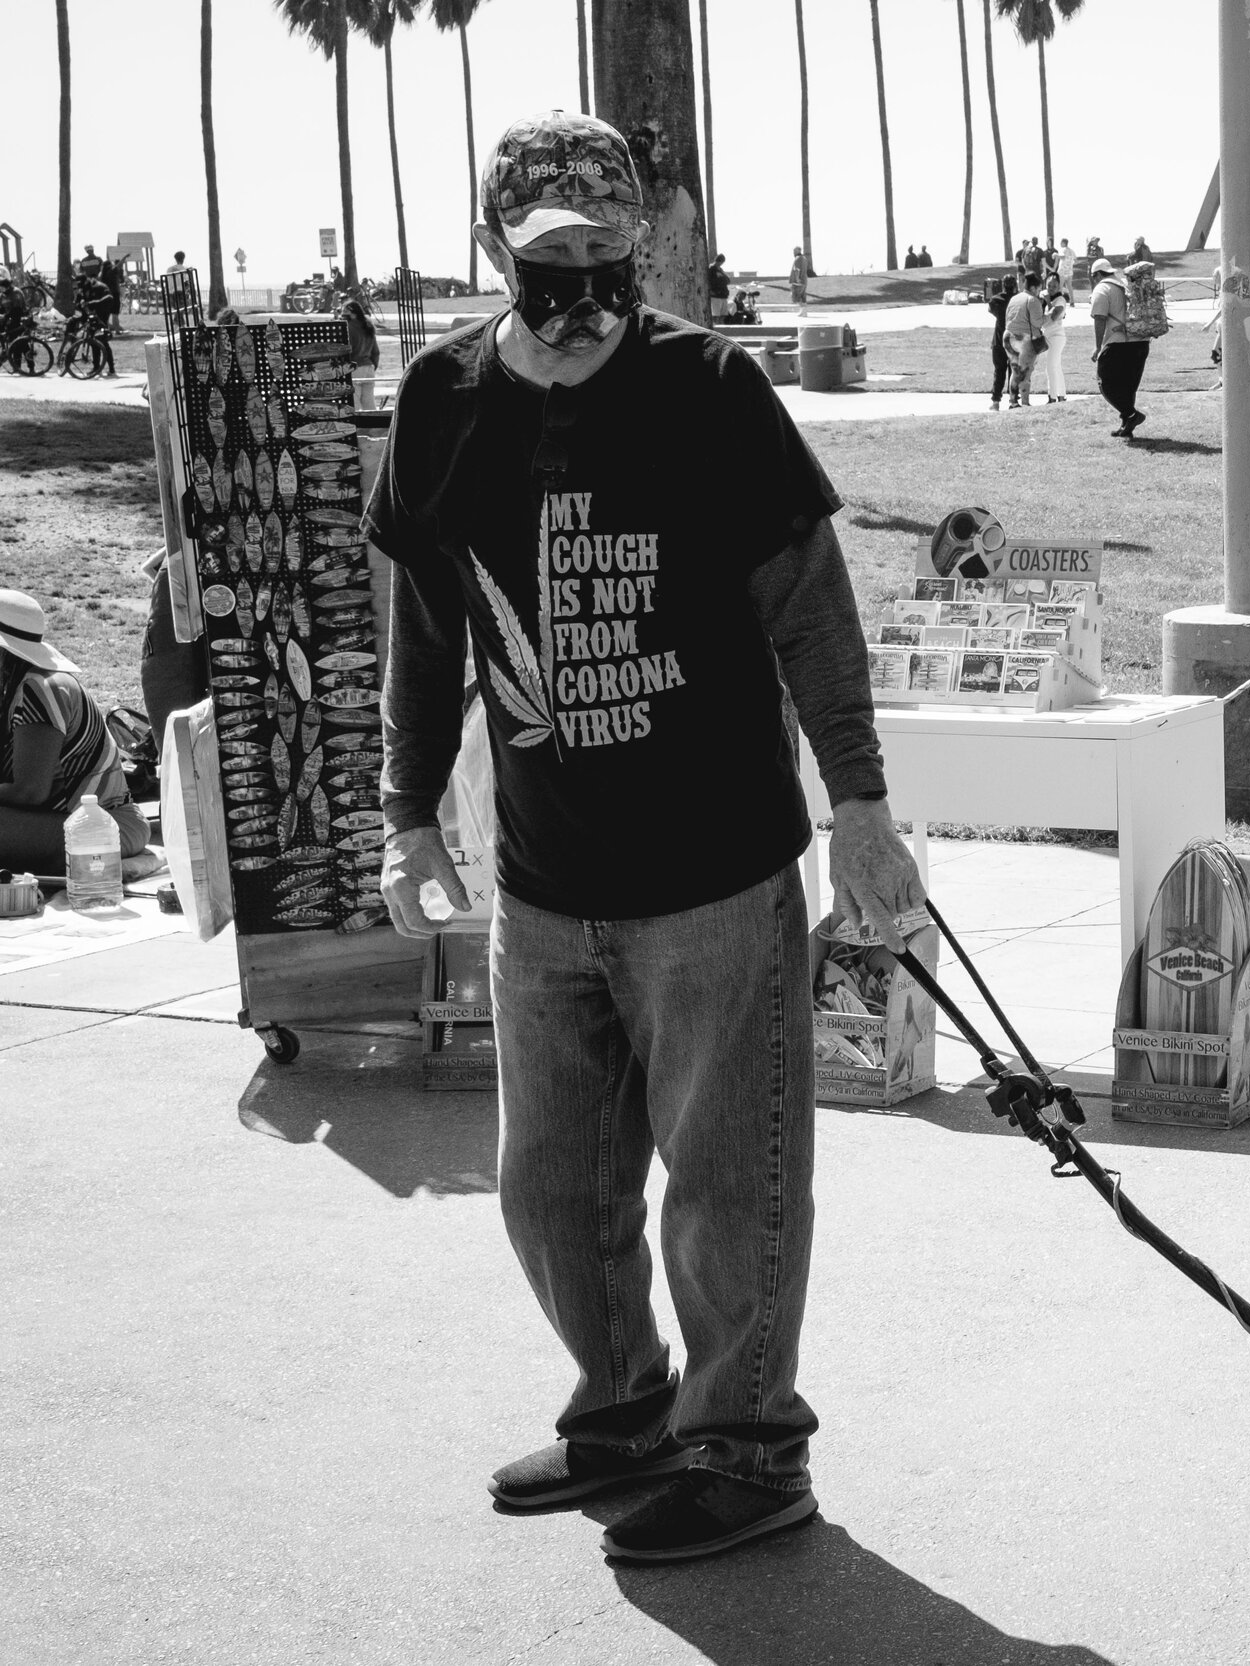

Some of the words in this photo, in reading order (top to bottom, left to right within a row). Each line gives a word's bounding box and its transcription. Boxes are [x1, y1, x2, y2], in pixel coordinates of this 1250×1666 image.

[550, 492, 592, 531] MY
[551, 534, 659, 574] COUGH
[1009, 548, 1089, 573] COASTERS
[552, 578, 581, 617] IS
[592, 575, 656, 615] NOT
[553, 619, 639, 661] FROM
[557, 650, 687, 705] CORONA
[557, 701, 651, 747] VIRUS
[1159, 952, 1193, 971] Venice
[1194, 951, 1224, 974] Beach
[1176, 969, 1203, 982] California
[425, 1006, 469, 1020] Venice
[827, 1018, 857, 1031] Bikini
[858, 1020, 885, 1034] Spot
[1117, 1034, 1158, 1048] Venice
[1162, 1036, 1194, 1051] Bikini
[1196, 1040, 1226, 1054] Spot
[854, 1071, 885, 1083] Coated
[852, 1086, 885, 1099] California
[1113, 1087, 1137, 1098] Hand
[1140, 1088, 1171, 1101] Shaped
[1191, 1109, 1228, 1121] California
